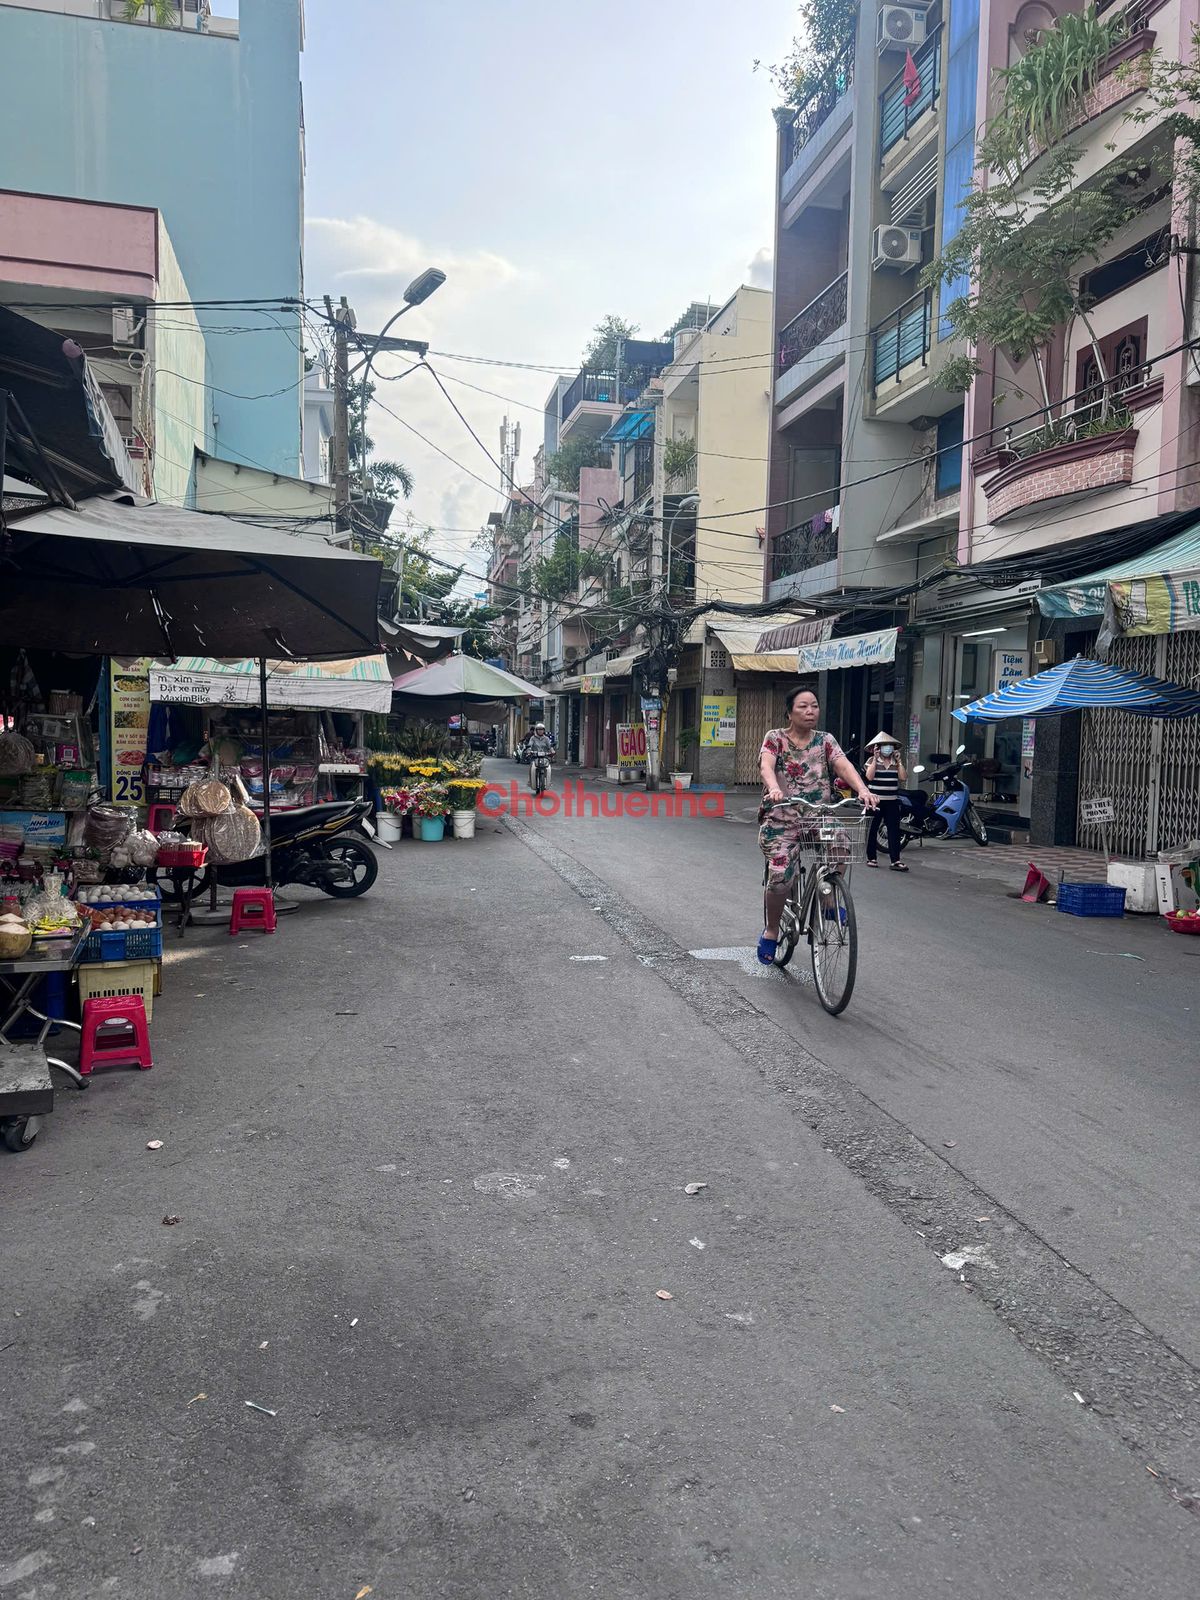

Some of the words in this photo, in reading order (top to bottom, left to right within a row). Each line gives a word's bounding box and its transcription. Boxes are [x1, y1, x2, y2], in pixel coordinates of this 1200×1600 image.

[1002, 654, 1023, 666] Tiệm
[1001, 666, 1023, 677] Làm
[115, 775, 144, 801] 25
